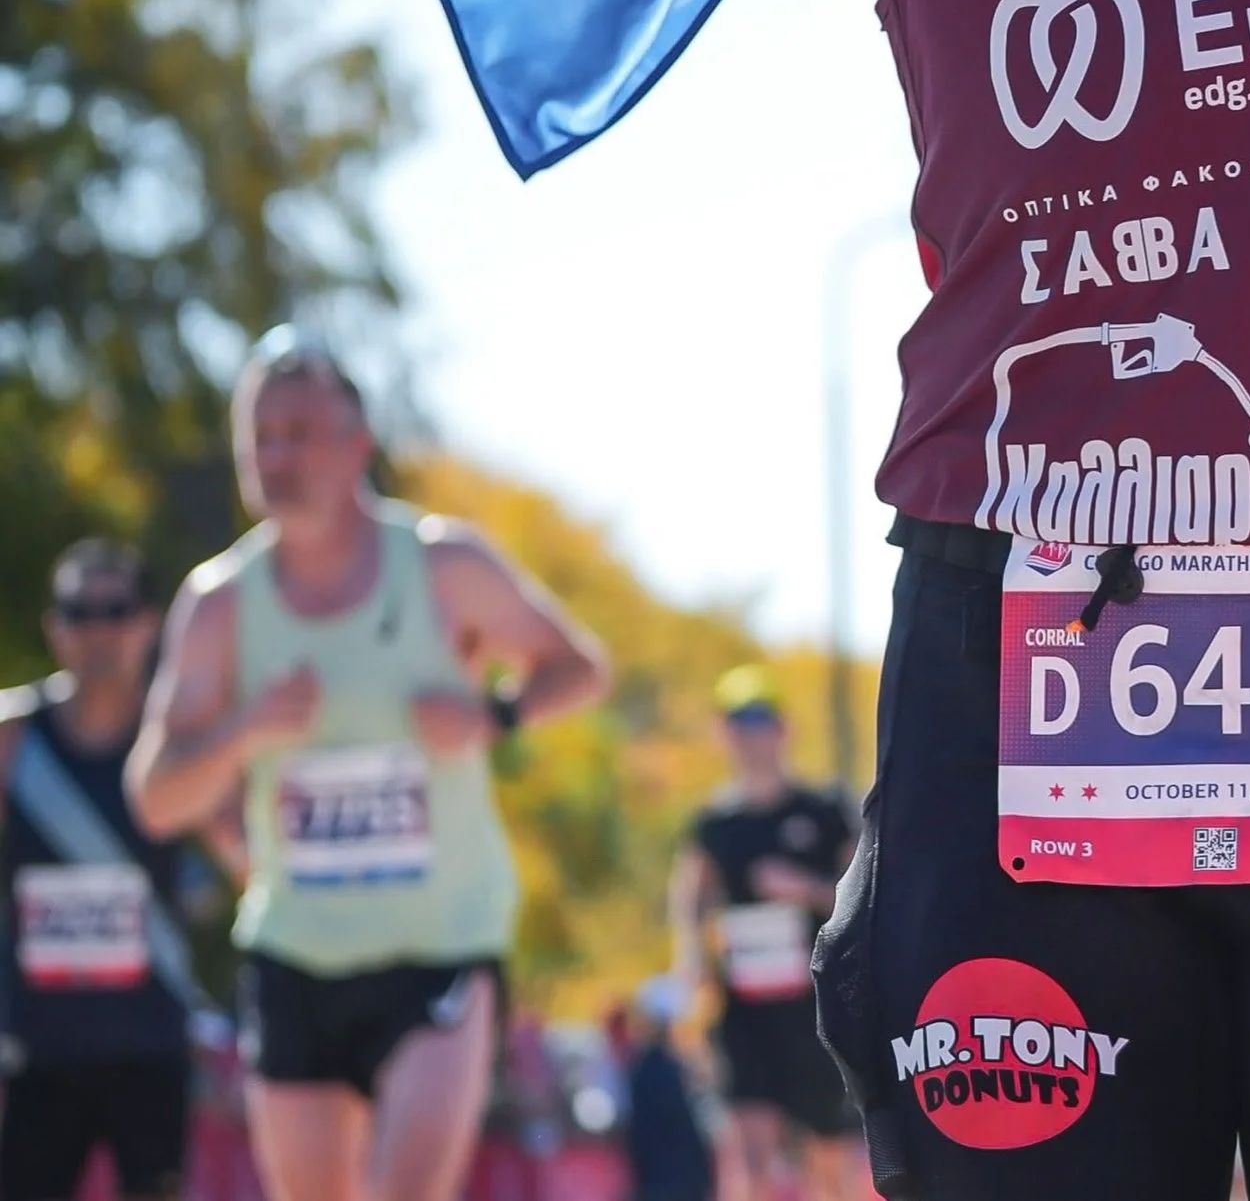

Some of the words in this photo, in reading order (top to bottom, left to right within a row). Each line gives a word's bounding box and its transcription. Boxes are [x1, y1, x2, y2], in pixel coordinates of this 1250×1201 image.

[1003, 184, 1118, 223] ΟΠΤΙΚΑ
[1025, 628, 1085, 647] CORRAL
[1029, 656, 1081, 735] D
[1125, 783, 1220, 800] OCTOBER
[1030, 839, 1077, 856] ROW
[1081, 842, 1093, 857] 3
[922, 1068, 1080, 1113] DONUTS
